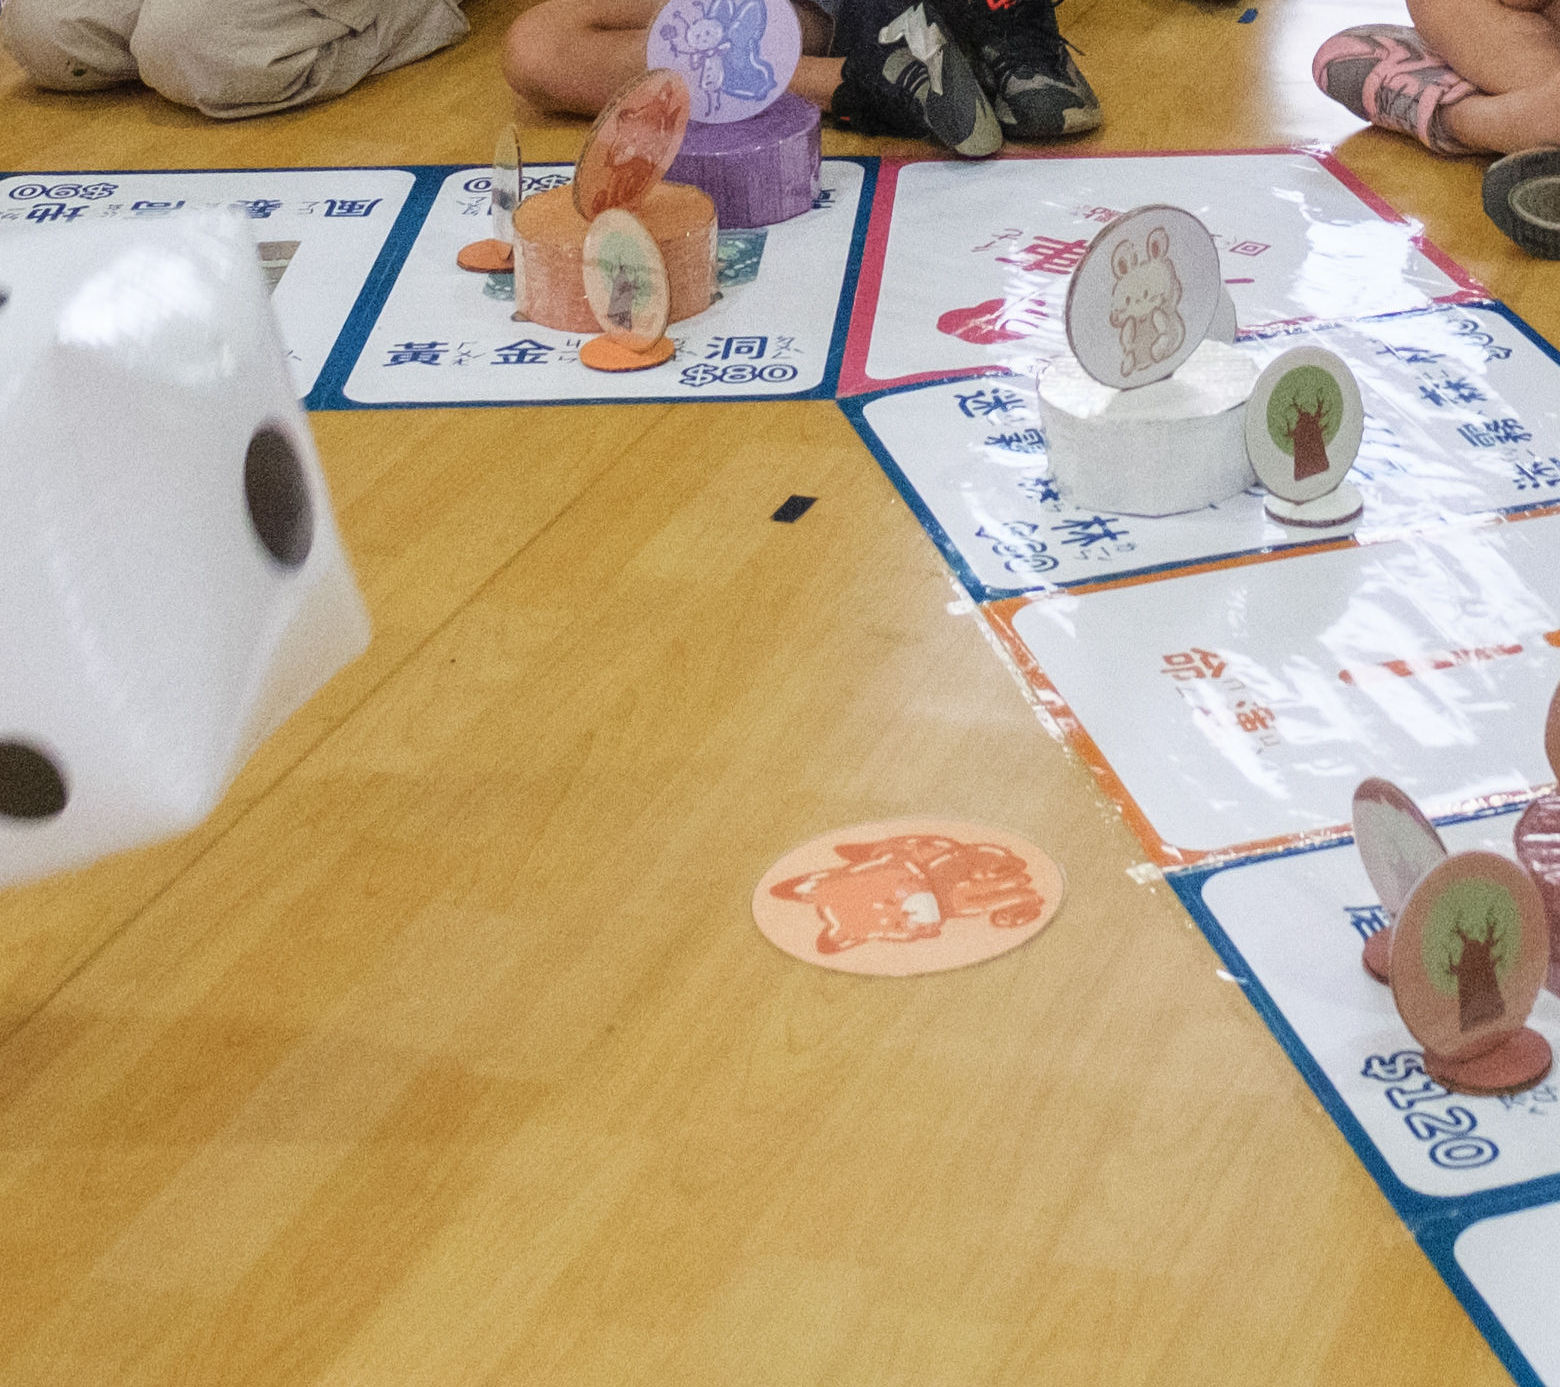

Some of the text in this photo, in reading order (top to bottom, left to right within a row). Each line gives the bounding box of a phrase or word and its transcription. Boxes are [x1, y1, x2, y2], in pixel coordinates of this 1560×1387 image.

[382, 335, 768, 367] 黃金洞
[678, 363, 799, 386] $80
[1360, 1049, 1500, 1170] $120
